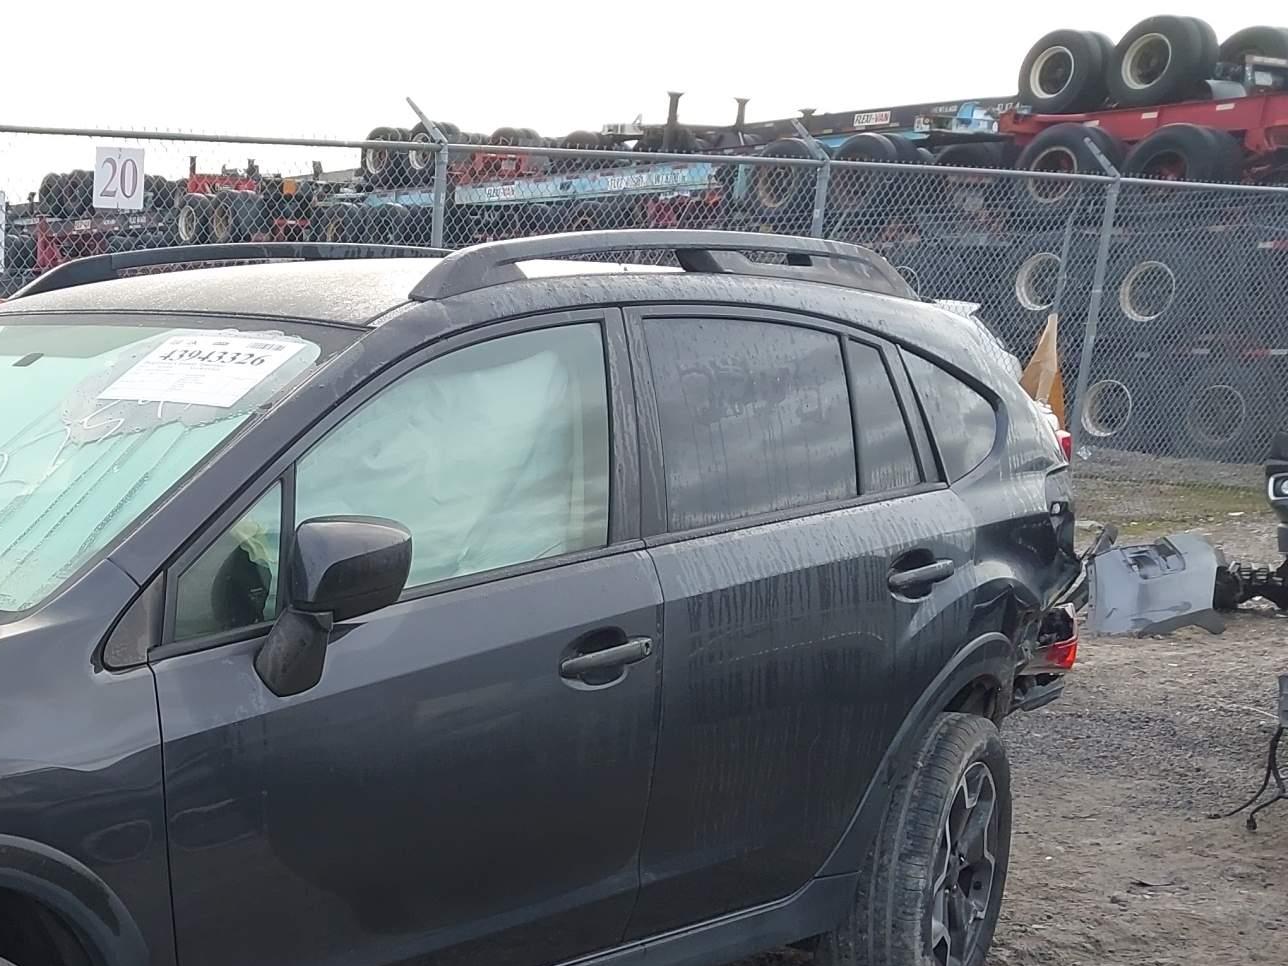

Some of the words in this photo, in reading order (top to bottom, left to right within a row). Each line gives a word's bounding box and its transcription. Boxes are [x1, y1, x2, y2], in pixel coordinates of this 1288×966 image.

[855, 112, 890, 125] FLEXI-VAN
[100, 157, 138, 199] 20
[160, 348, 267, 367] 43943326
